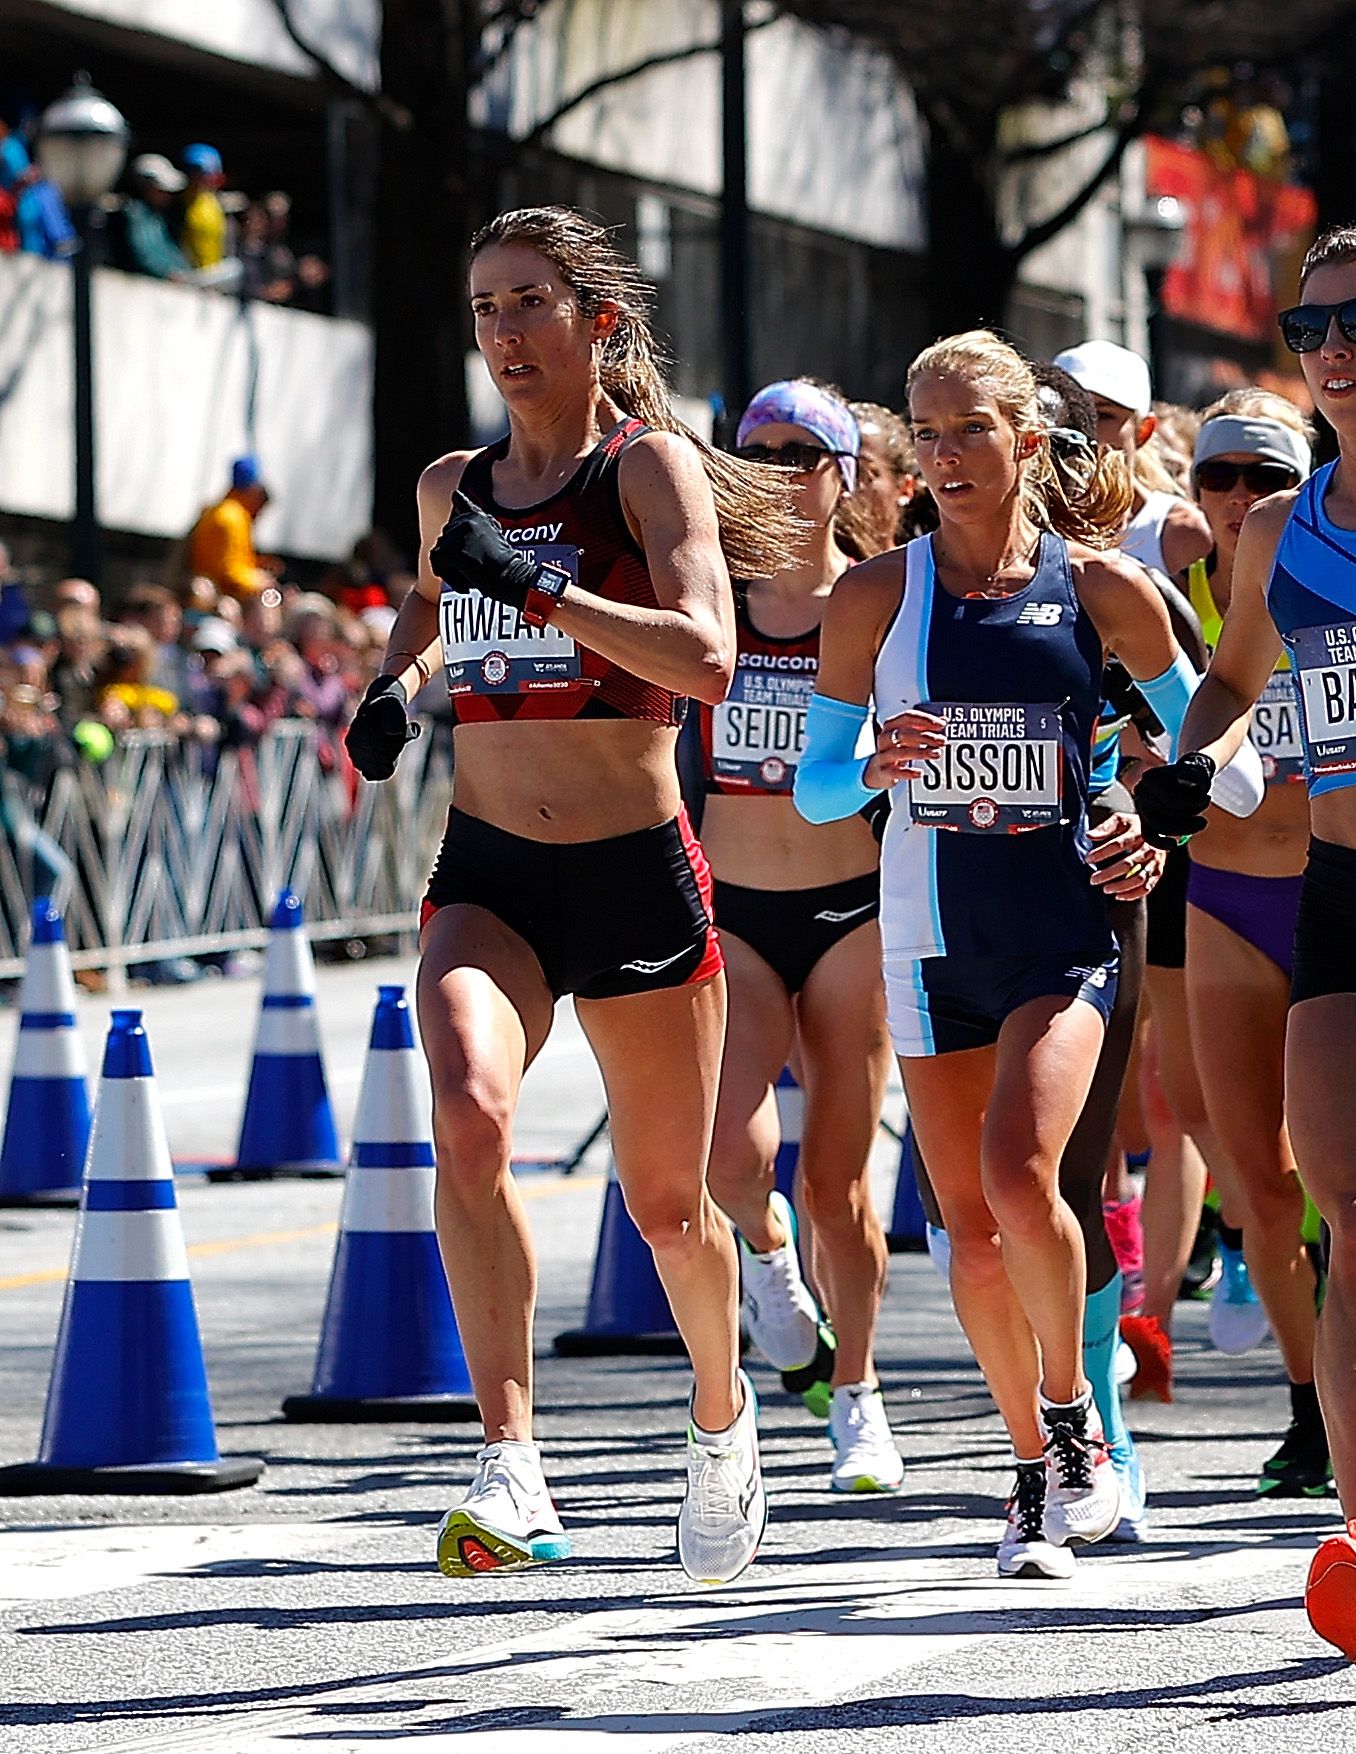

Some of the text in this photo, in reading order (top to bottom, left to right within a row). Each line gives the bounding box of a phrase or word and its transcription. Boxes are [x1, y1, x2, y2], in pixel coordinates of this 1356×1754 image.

[442, 597, 564, 645] THWEA
[1325, 628, 1351, 647] U.S.
[737, 652, 818, 670] saucon
[726, 706, 807, 752] SEIDE
[943, 708, 1025, 722] U.S. OLYMPIC
[1256, 706, 1294, 748] SA
[980, 724, 1025, 738] TRIALS
[923, 743, 1045, 791] SISSON
